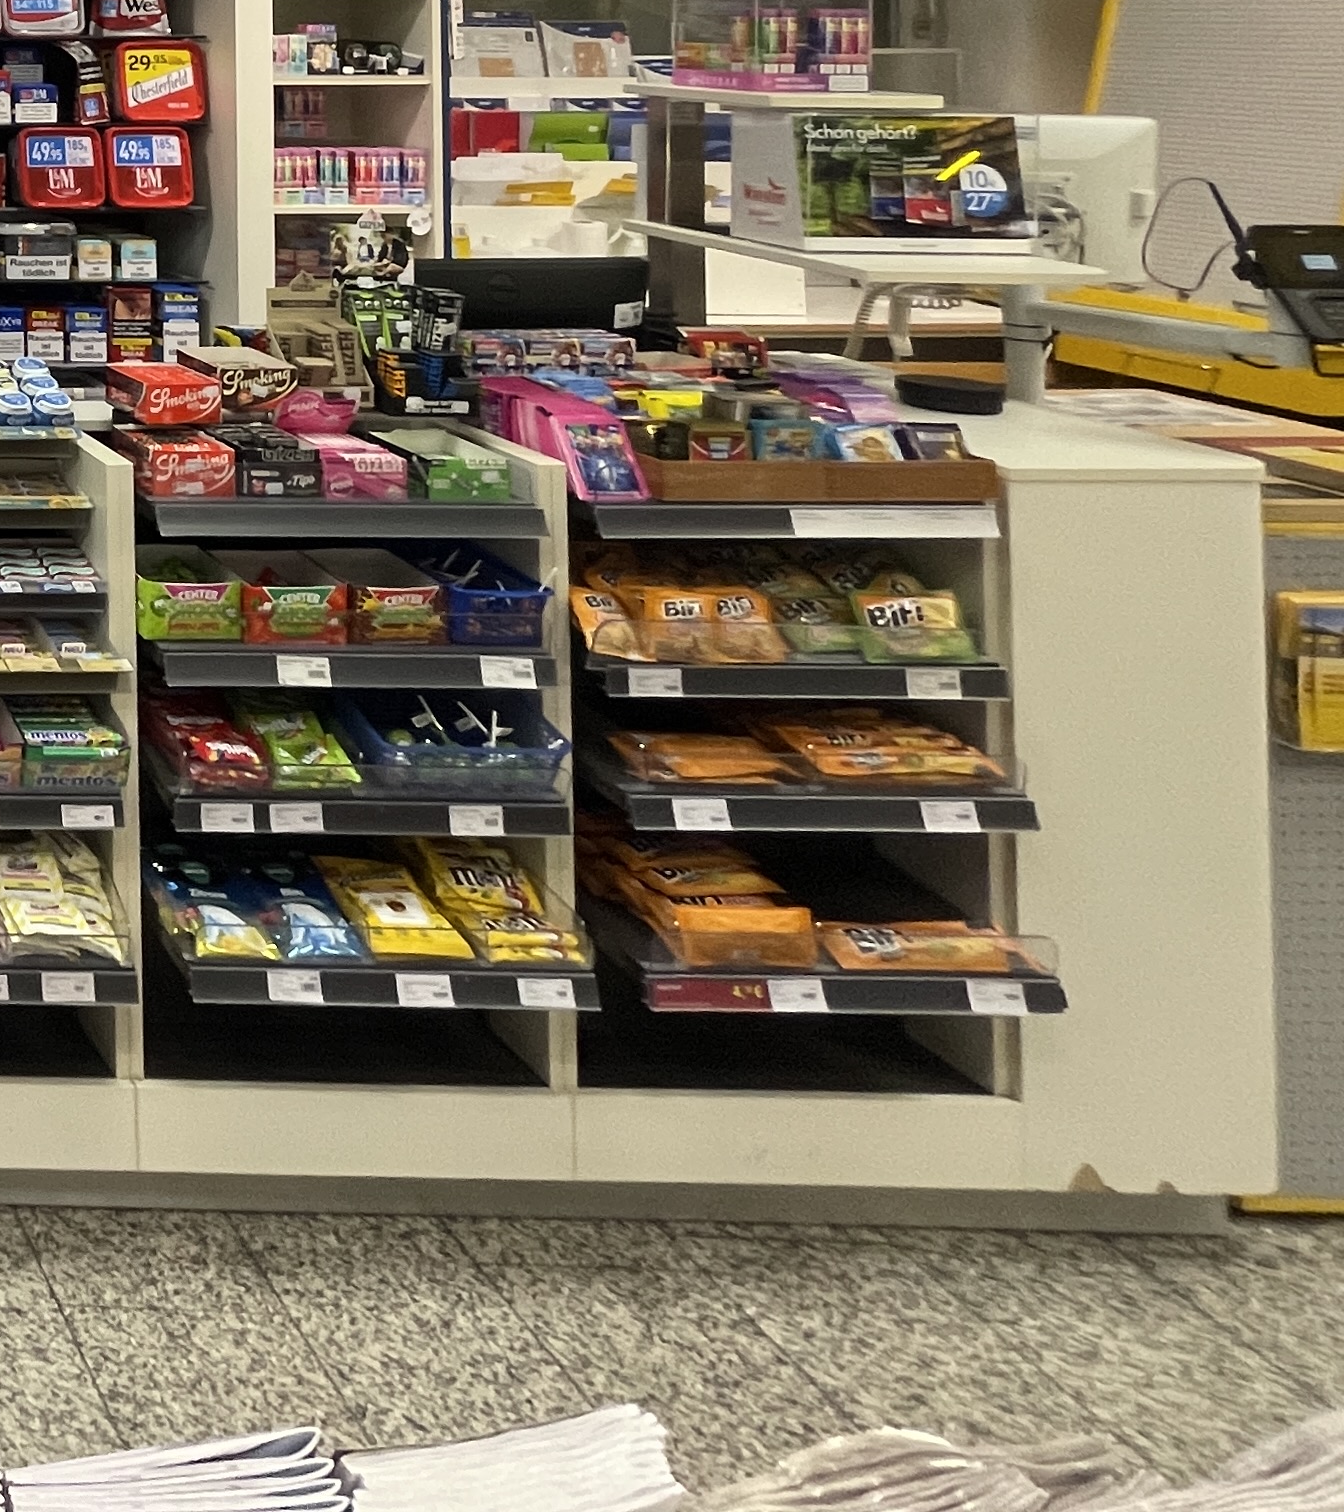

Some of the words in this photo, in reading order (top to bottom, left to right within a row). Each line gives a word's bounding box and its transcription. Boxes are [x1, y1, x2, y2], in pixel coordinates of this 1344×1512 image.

[125, 0, 159, 14] Wes
[129, 69, 188, 103] Chesterfield
[803, 125, 851, 139] Schon
[853, 125, 917, 143] gehört?
[10, 259, 54, 267] Rauchen
[22, 269, 56, 277] tödlich
[222, 369, 291, 395] Smoking
[149, 386, 220, 413] Smoking
[155, 453, 230, 481] Sming
[31, 730, 87, 741] mentos
[36, 775, 116, 786] mentos
